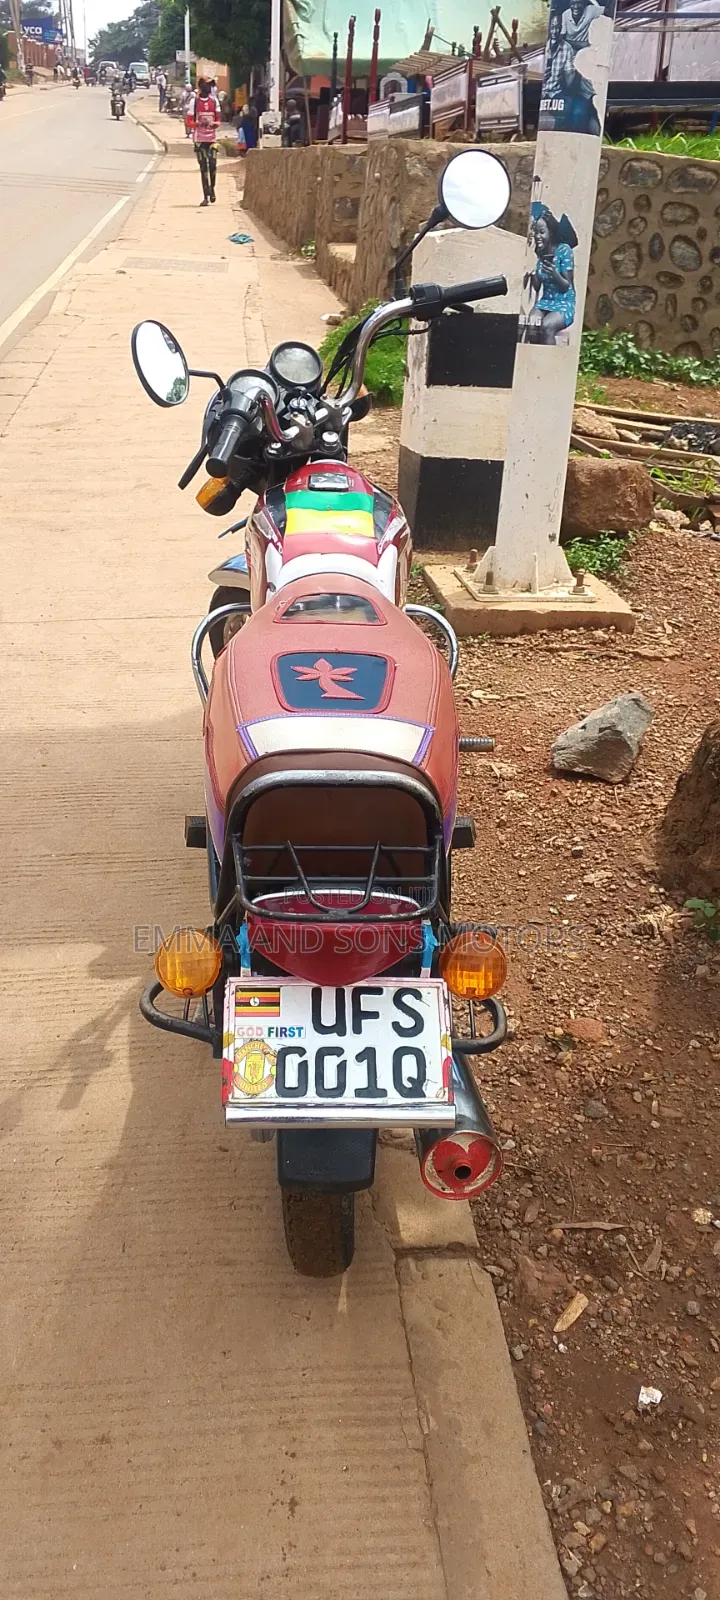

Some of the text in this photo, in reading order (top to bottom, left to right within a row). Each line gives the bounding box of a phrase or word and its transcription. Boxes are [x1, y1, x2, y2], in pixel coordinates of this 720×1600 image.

[237, 1026, 304, 1038] GOD FIRST
[311, 986, 425, 1037] UFS
[275, 1046, 427, 1098] 001Q
